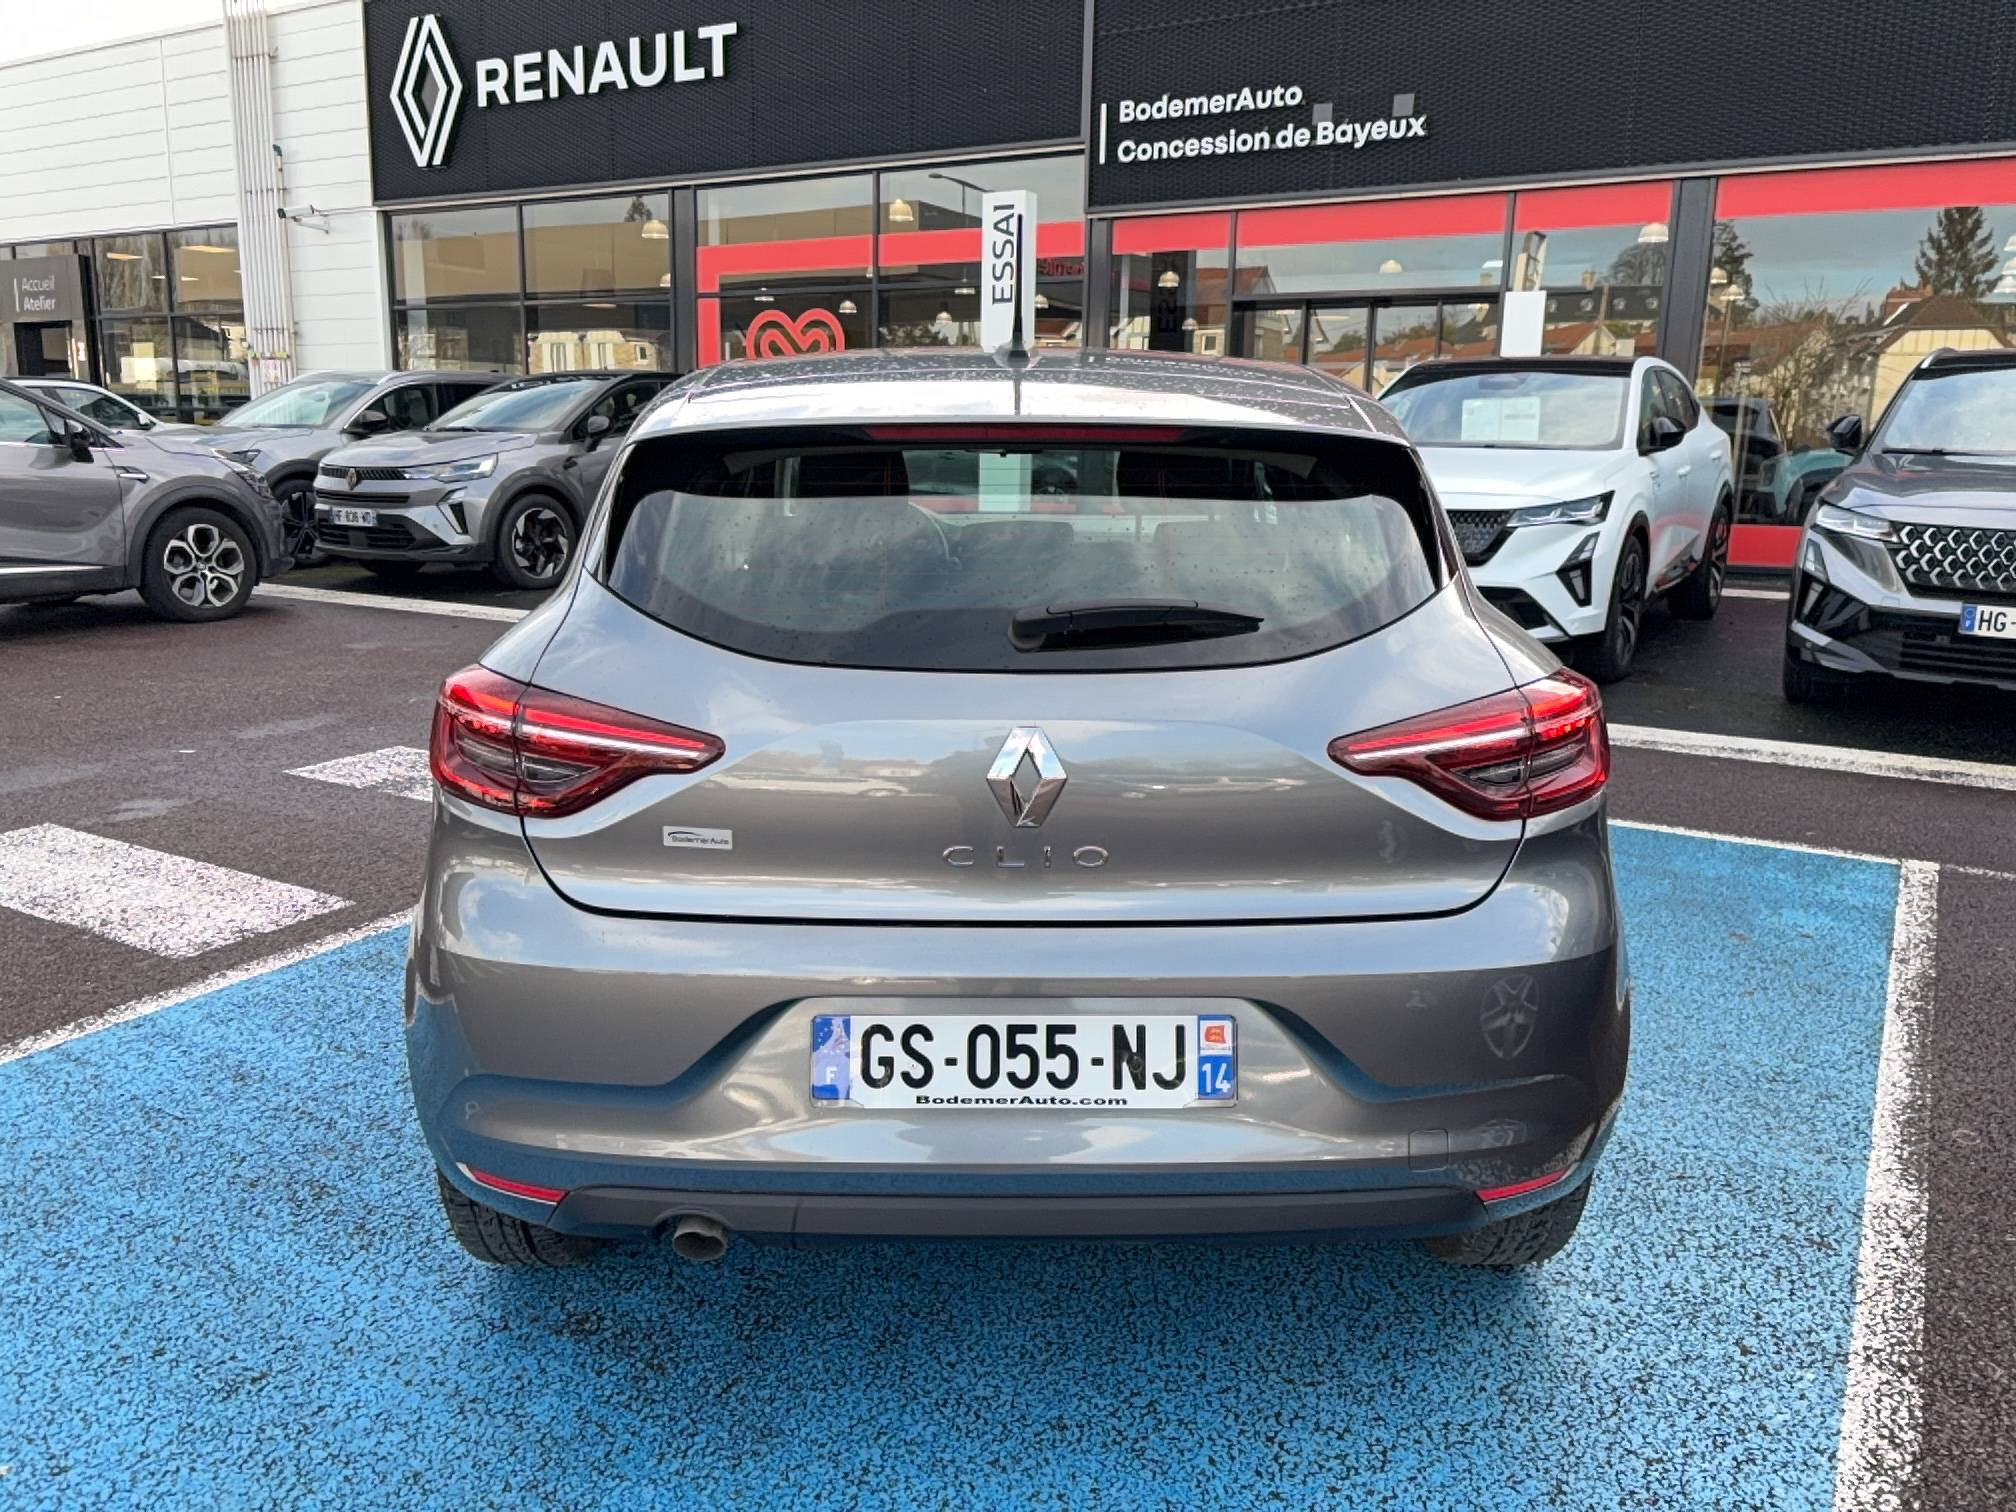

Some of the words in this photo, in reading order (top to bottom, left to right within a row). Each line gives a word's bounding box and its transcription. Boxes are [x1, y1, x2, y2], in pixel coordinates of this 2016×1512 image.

[476, 22, 738, 108] RENAULT
[1118, 85, 1303, 123] BodemerAuto
[1116, 128, 1271, 164] Concession
[1275, 123, 1311, 150] de
[1316, 114, 1427, 149] Bayeux
[991, 203, 1016, 306] ESSAI
[21, 275, 56, 292] Accueil
[23, 295, 57, 312] Atelier
[942, 845, 1109, 869] CLIO
[861, 1023, 1186, 1091] GS-055-NJ
[825, 1067, 838, 1085] F
[1201, 1063, 1232, 1094] 14
[915, 1095, 1128, 1107] BodemerAuto.com
